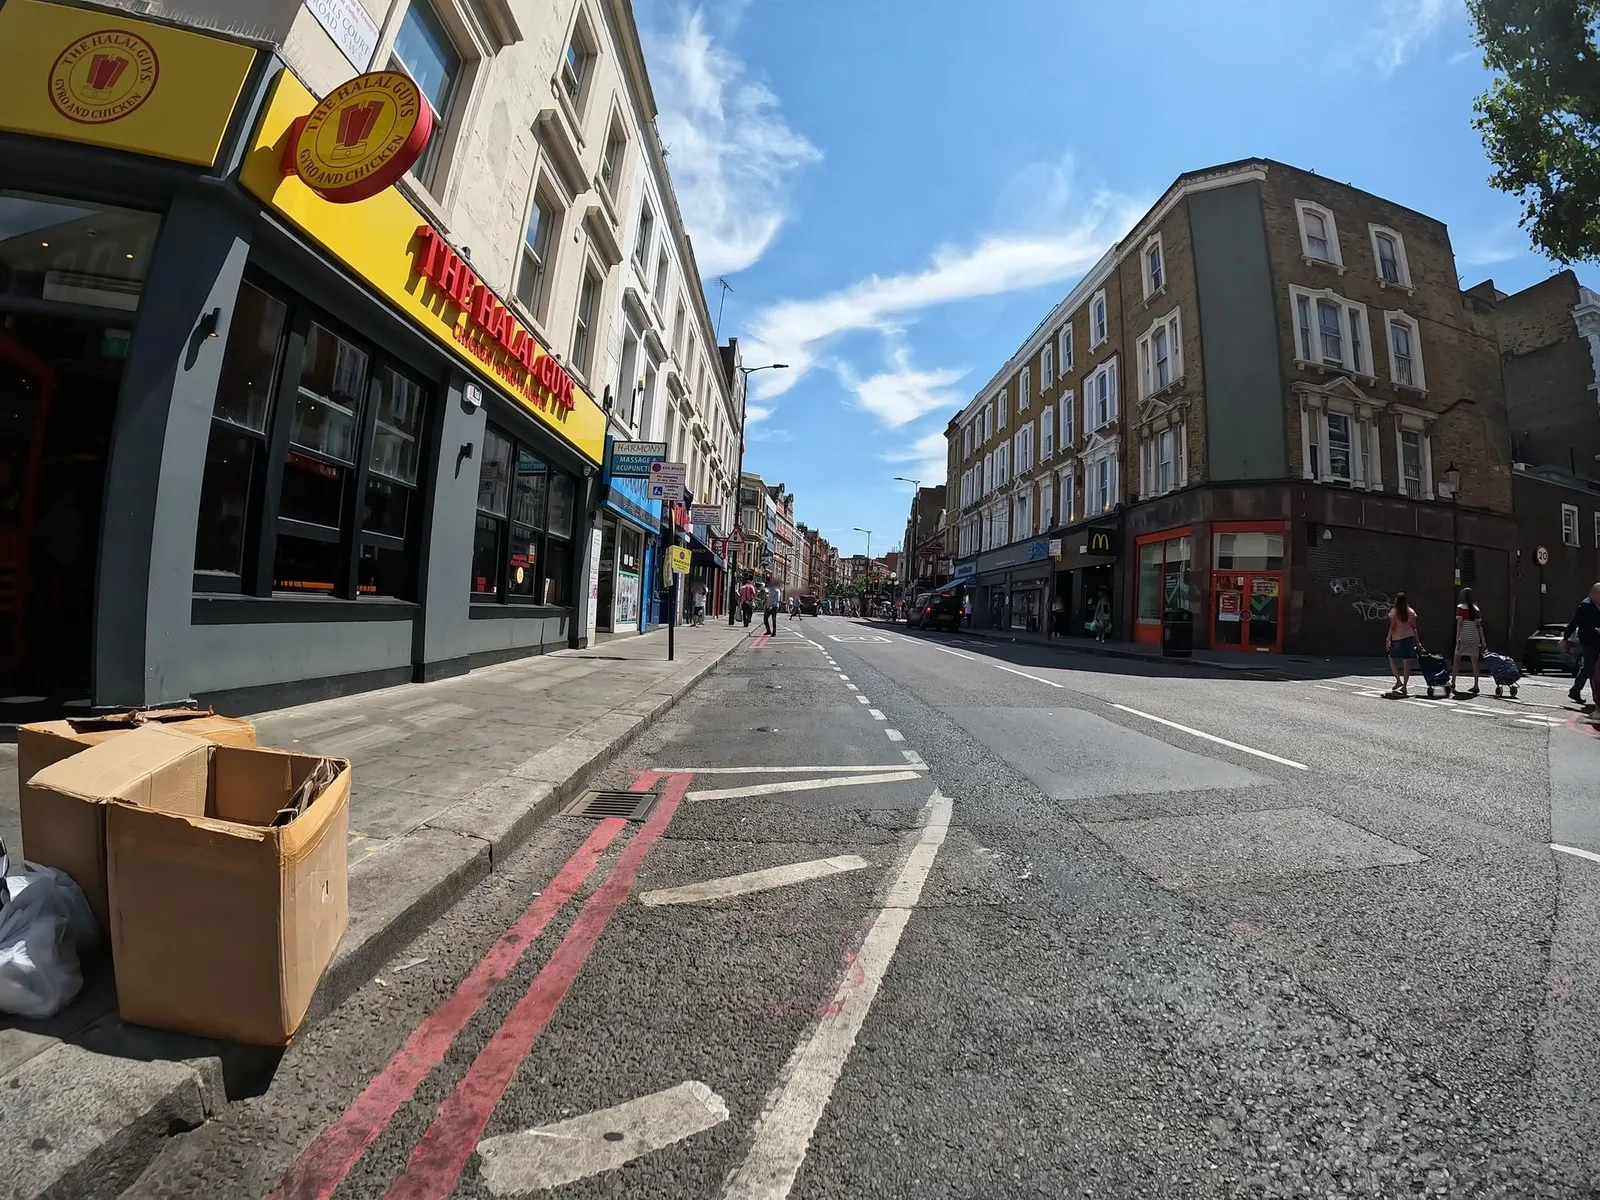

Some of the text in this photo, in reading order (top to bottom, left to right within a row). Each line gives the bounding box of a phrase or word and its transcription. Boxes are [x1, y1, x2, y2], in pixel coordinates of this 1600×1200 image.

[61, 41, 90, 66] THE
[92, 34, 138, 51] HALAL
[342, 17, 370, 55] COURT
[55, 78, 142, 119] GYRO AND CHICKEN
[305, 101, 337, 133] THE
[337, 76, 393, 100] HALAL
[300, 134, 405, 185] GYRO AND CHICKEN
[418, 224, 477, 313] THE
[472, 284, 539, 376] HALAL
[617, 443, 662, 453] HARMONY
[620, 456, 651, 464] MASSAGE
[616, 464, 650, 472] ACUPUNCT
[1539, 551, 1547, 560] 20
